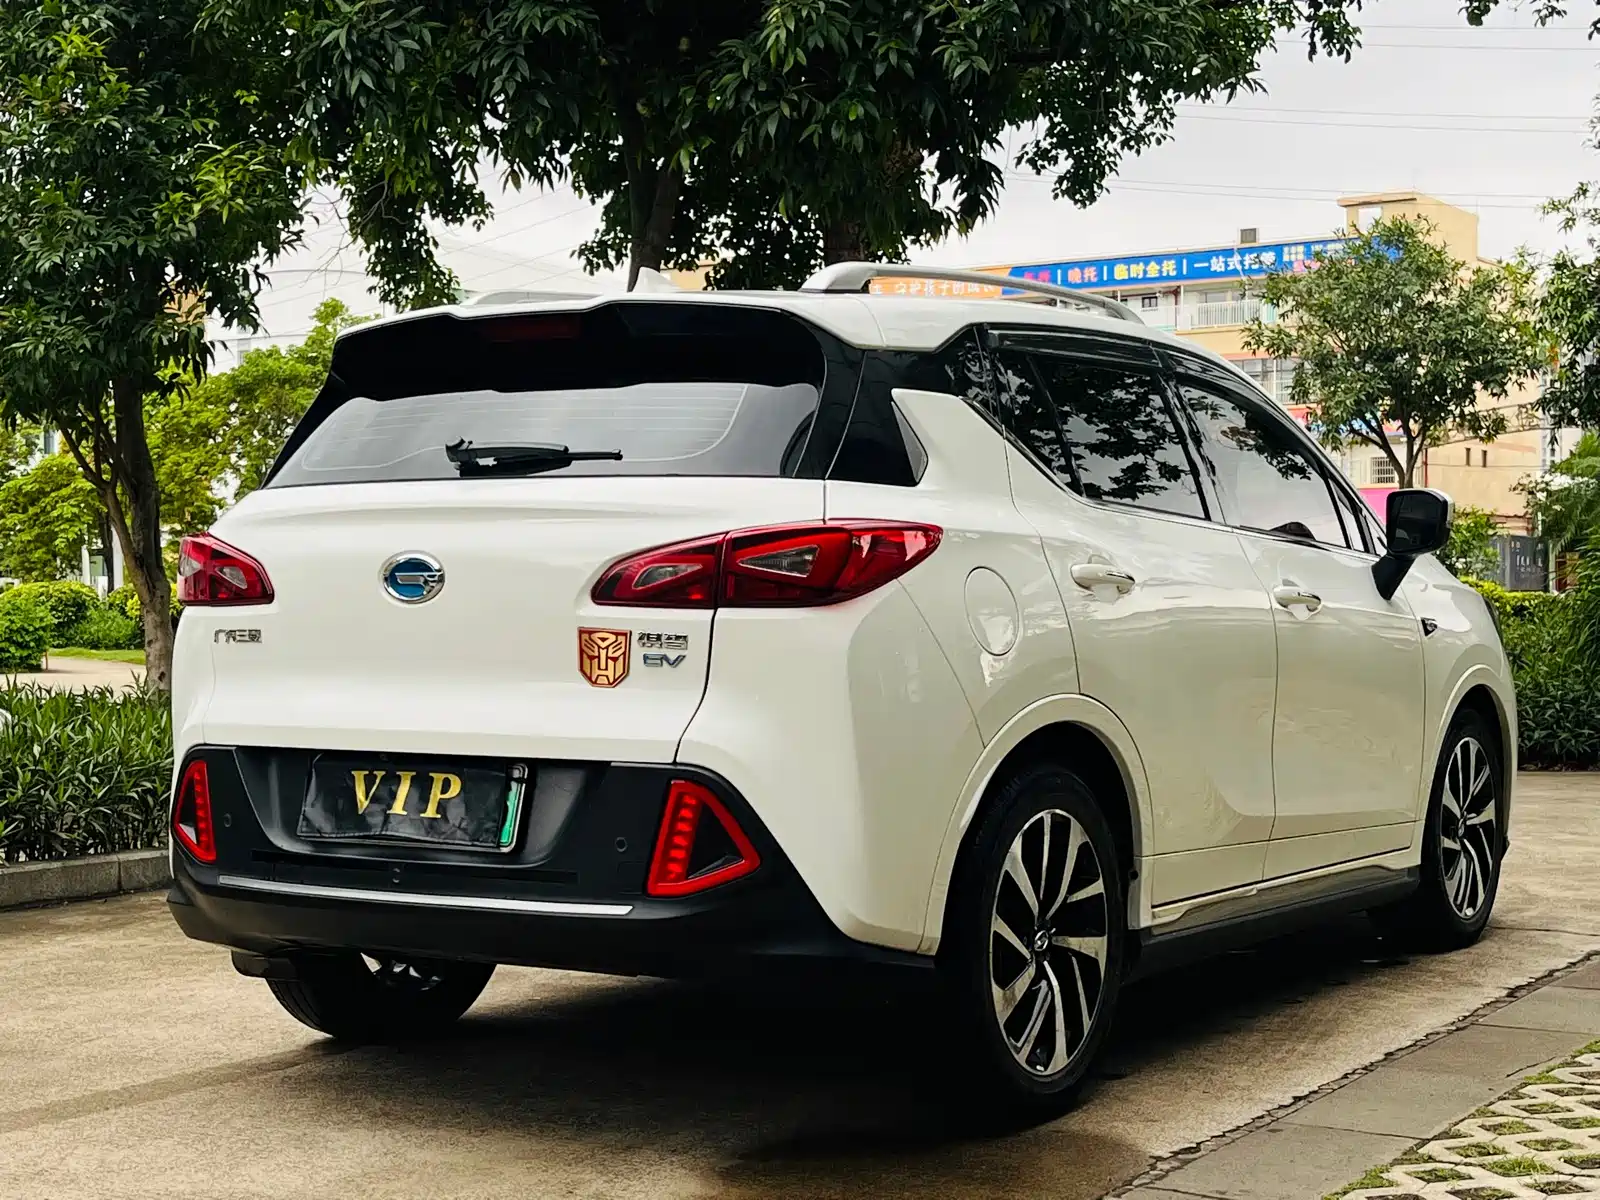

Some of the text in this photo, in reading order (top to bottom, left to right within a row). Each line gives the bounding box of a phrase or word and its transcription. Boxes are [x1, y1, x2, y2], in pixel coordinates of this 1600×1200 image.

[1113, 259, 1178, 280] 临时全托
[642, 652, 687, 668] EV
[351, 770, 462, 818] VIP
